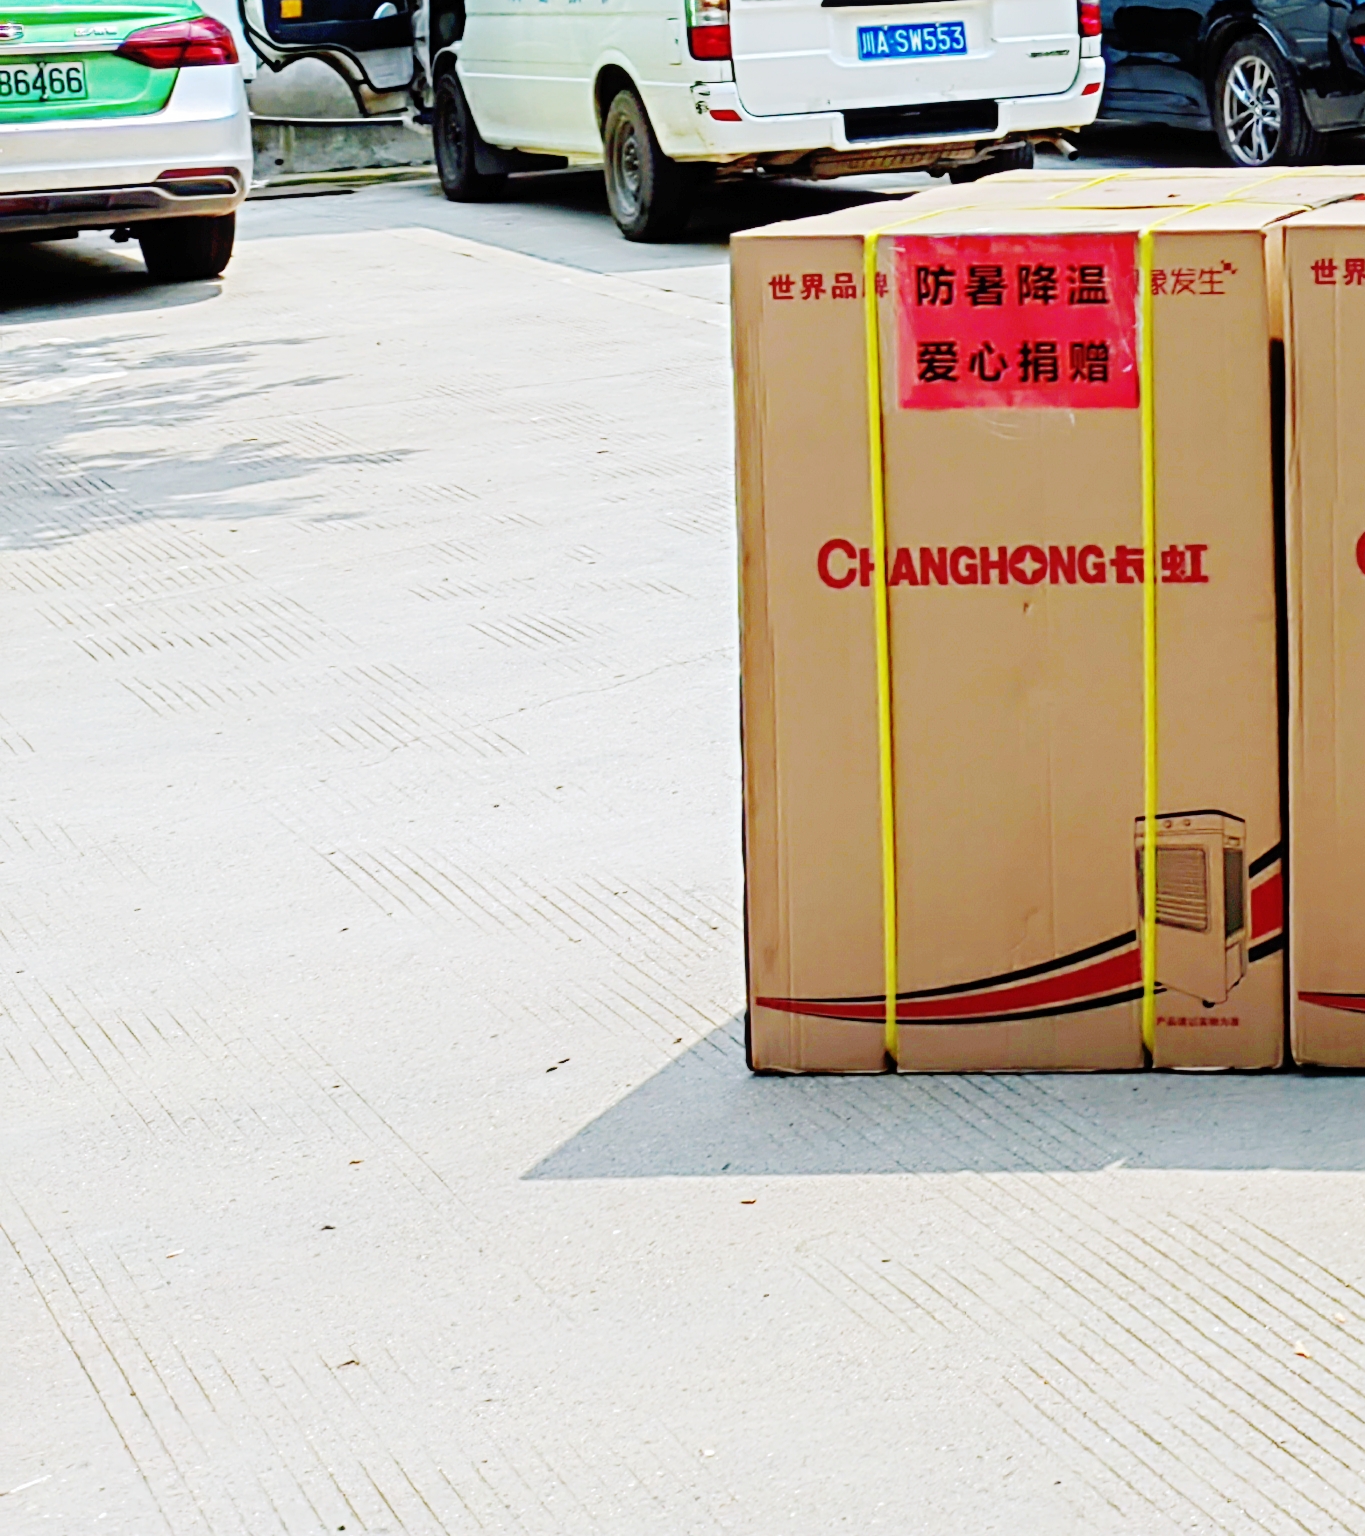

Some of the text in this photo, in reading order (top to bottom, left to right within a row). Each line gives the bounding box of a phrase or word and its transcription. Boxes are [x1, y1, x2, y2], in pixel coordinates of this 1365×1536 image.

[916, 265, 1110, 306] 防暑降温
[917, 341, 1110, 383] 爱心捐赠
